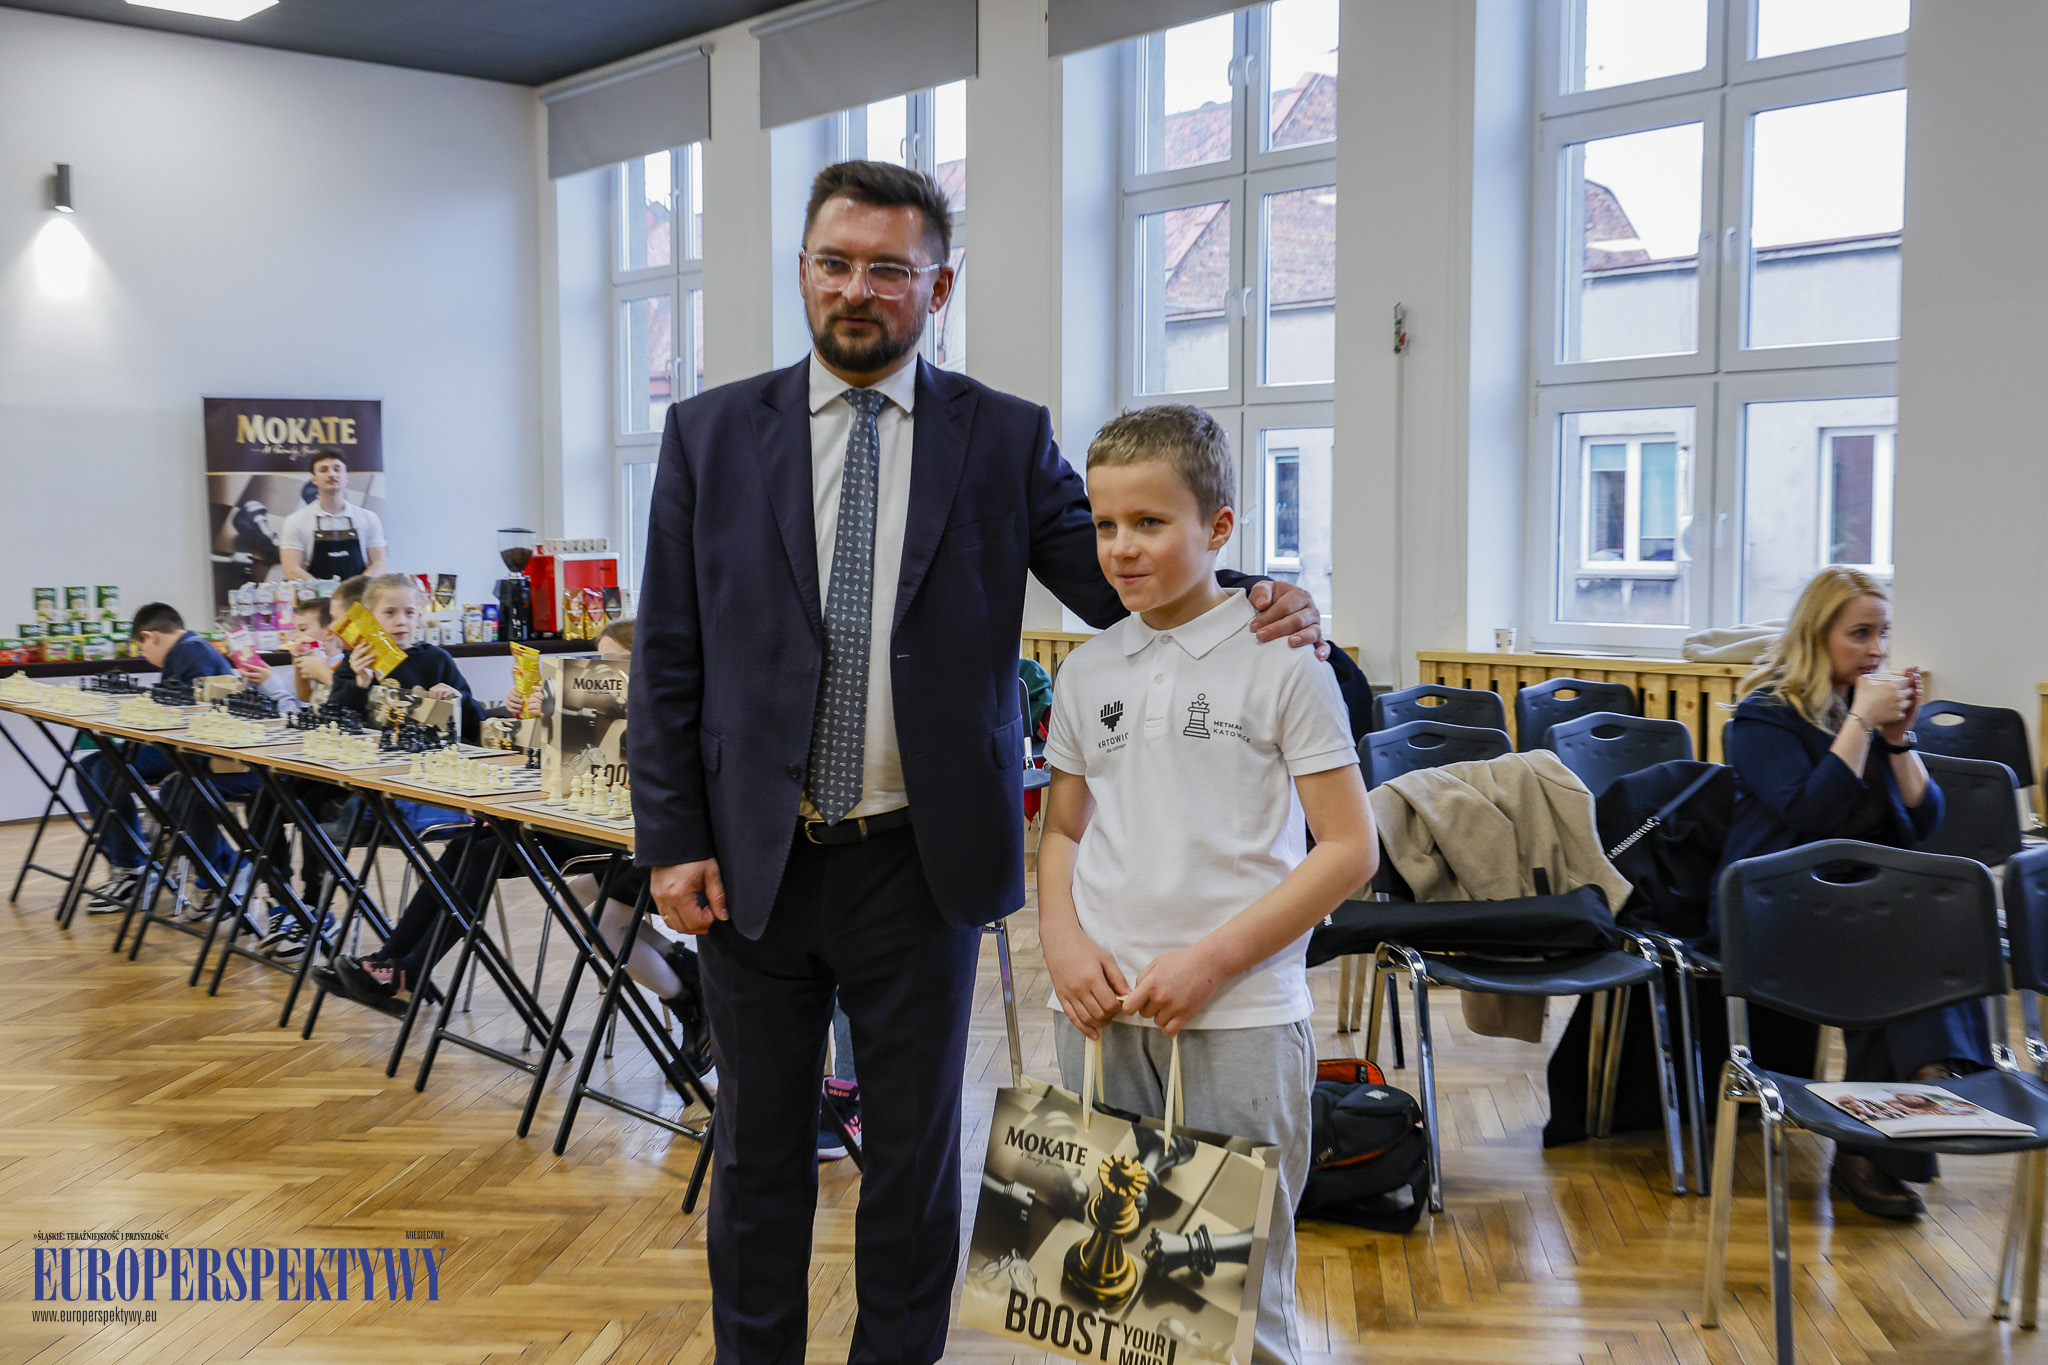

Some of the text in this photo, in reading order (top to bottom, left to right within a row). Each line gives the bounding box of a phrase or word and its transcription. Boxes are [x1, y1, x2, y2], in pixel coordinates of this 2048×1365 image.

[236, 414, 358, 444] MOKATE
[572, 677, 623, 691] MOKATE
[1213, 728, 1251, 744] KATOWCE
[1004, 1125, 1088, 1167] MOKATE
[1005, 1288, 1119, 1362] BOOST
[1123, 1323, 1167, 1357] YOUR
